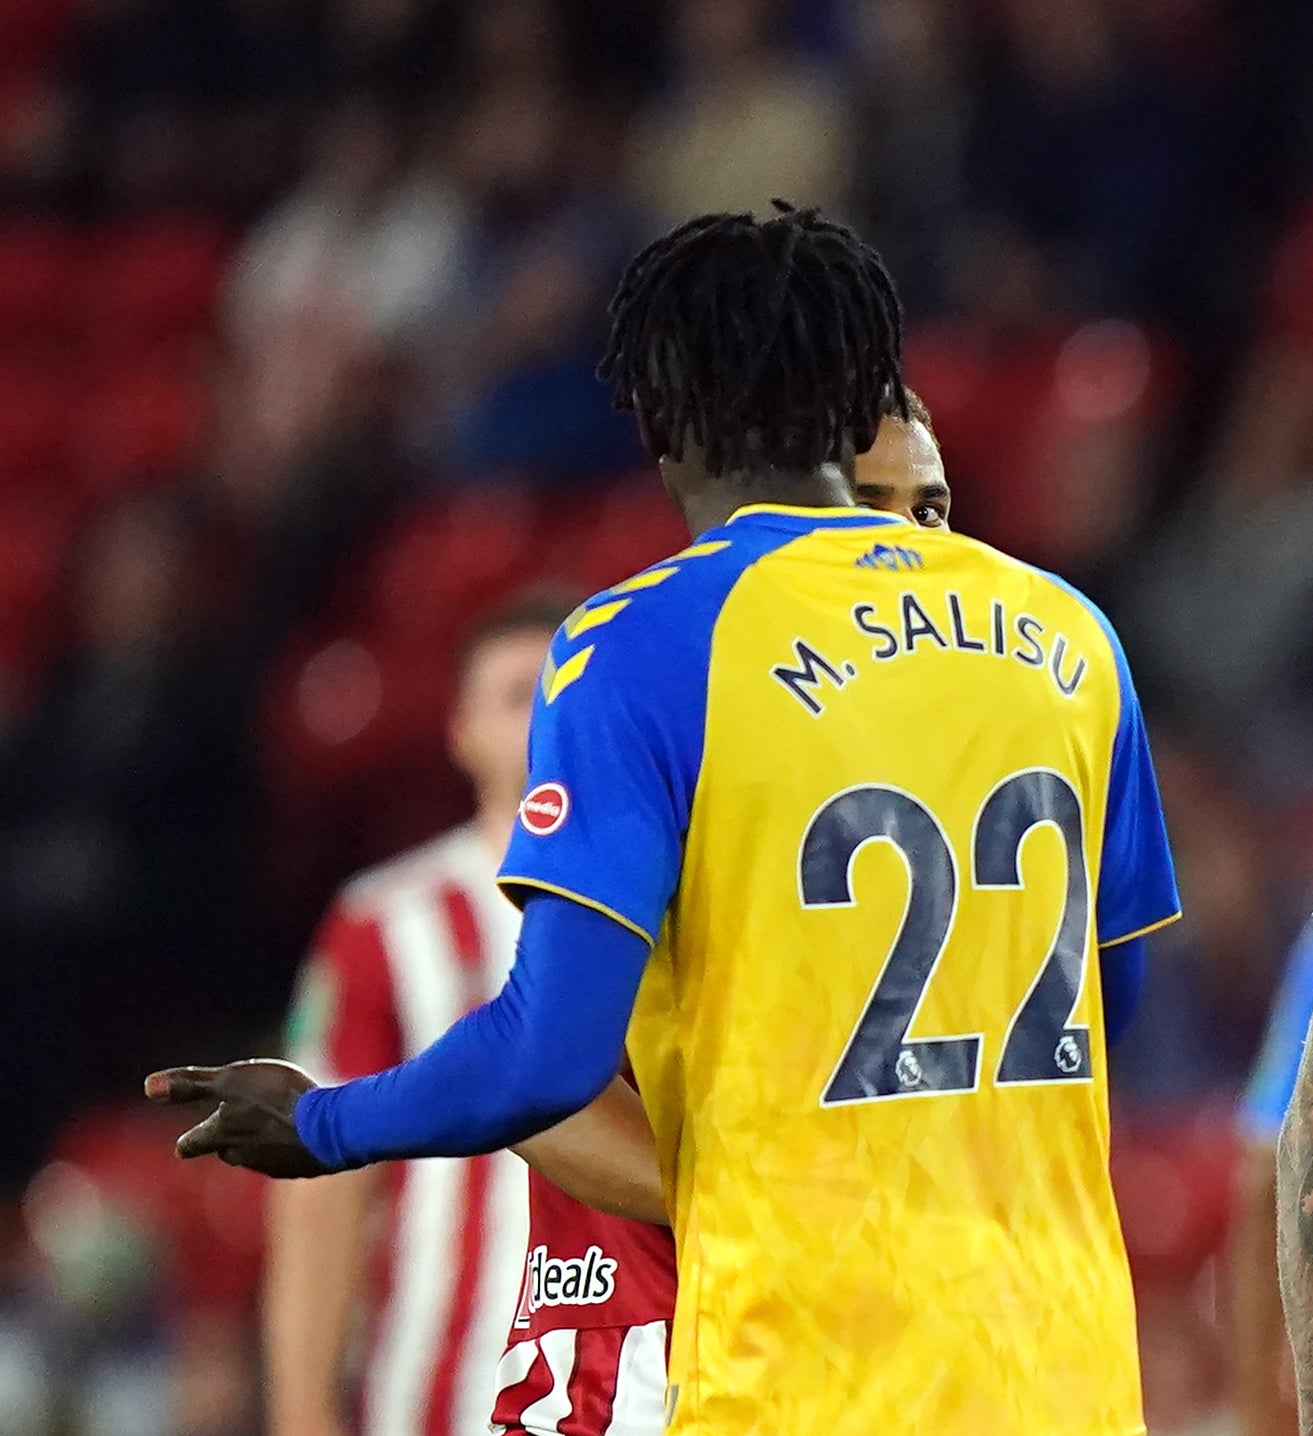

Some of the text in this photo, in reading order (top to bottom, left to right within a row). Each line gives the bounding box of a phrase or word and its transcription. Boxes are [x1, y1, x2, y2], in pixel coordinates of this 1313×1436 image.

[771, 591, 1087, 716] M. SALISU
[797, 766, 1095, 1109] 22
